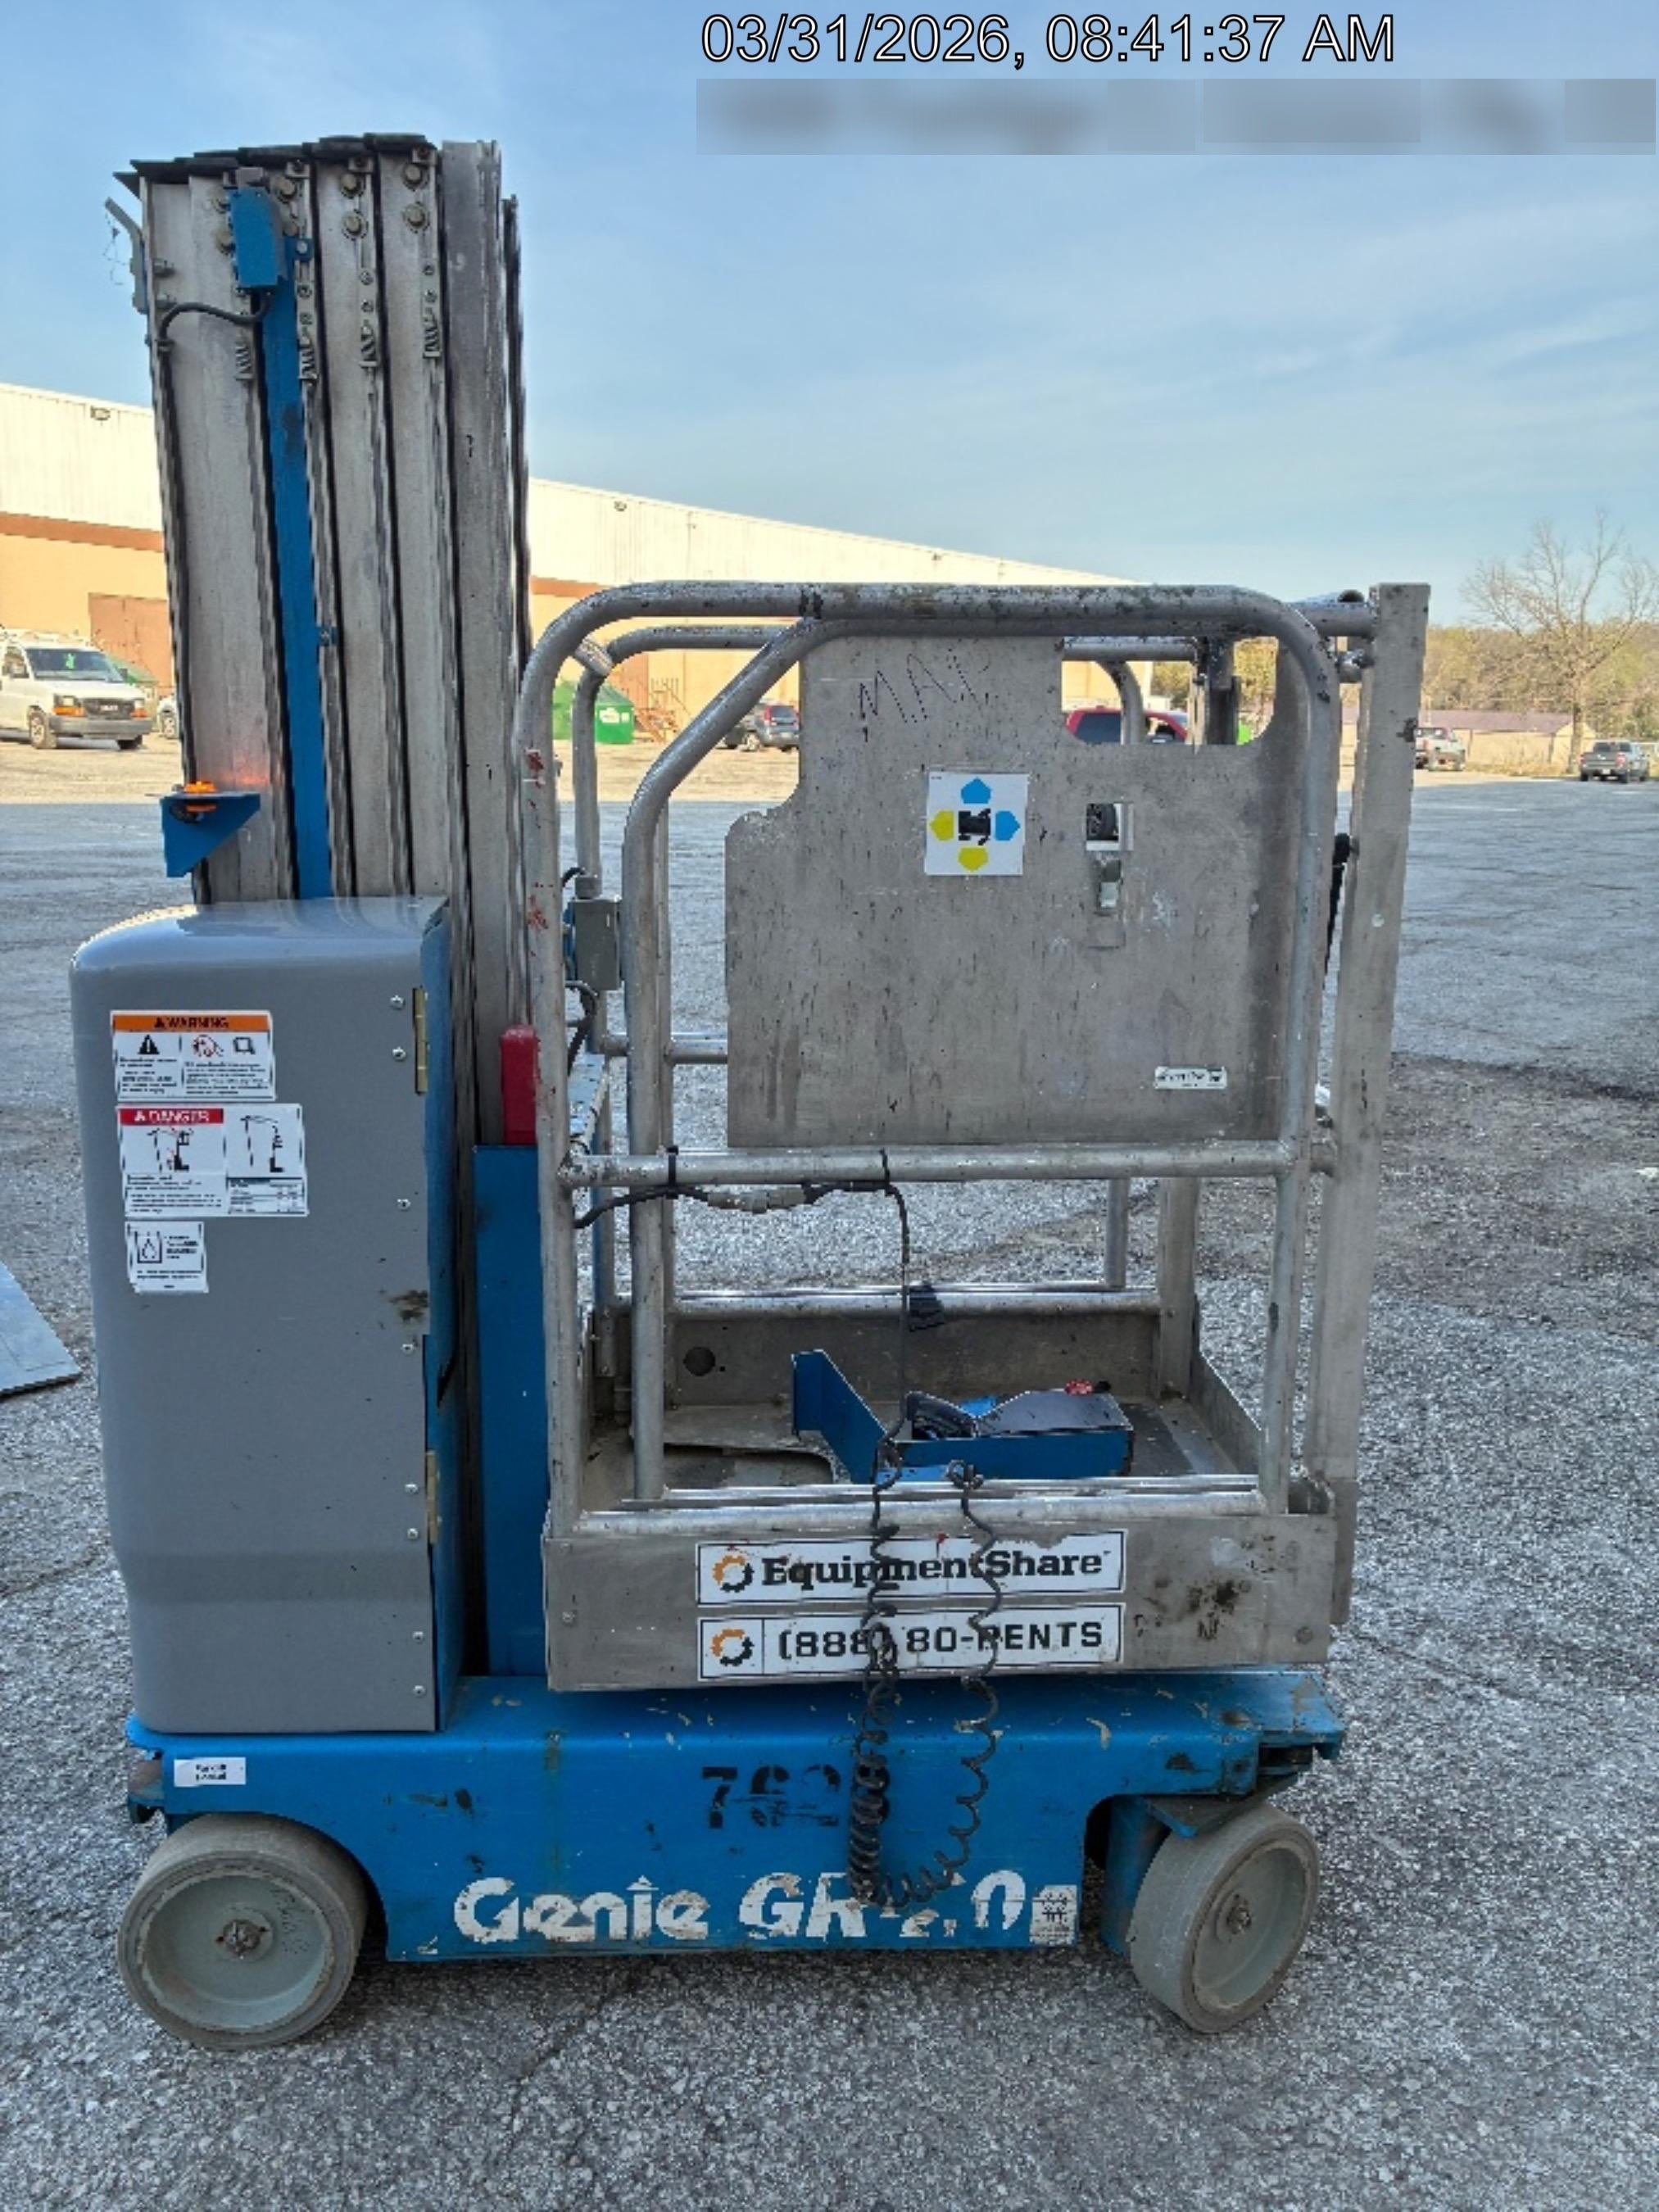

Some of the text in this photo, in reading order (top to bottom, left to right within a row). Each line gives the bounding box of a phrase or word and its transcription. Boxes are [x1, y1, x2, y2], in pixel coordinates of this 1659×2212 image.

[761, 1549, 1102, 1590] EquipmentShare
[779, 1629, 890, 1659] (888
[454, 1874, 710, 1943] Genie
